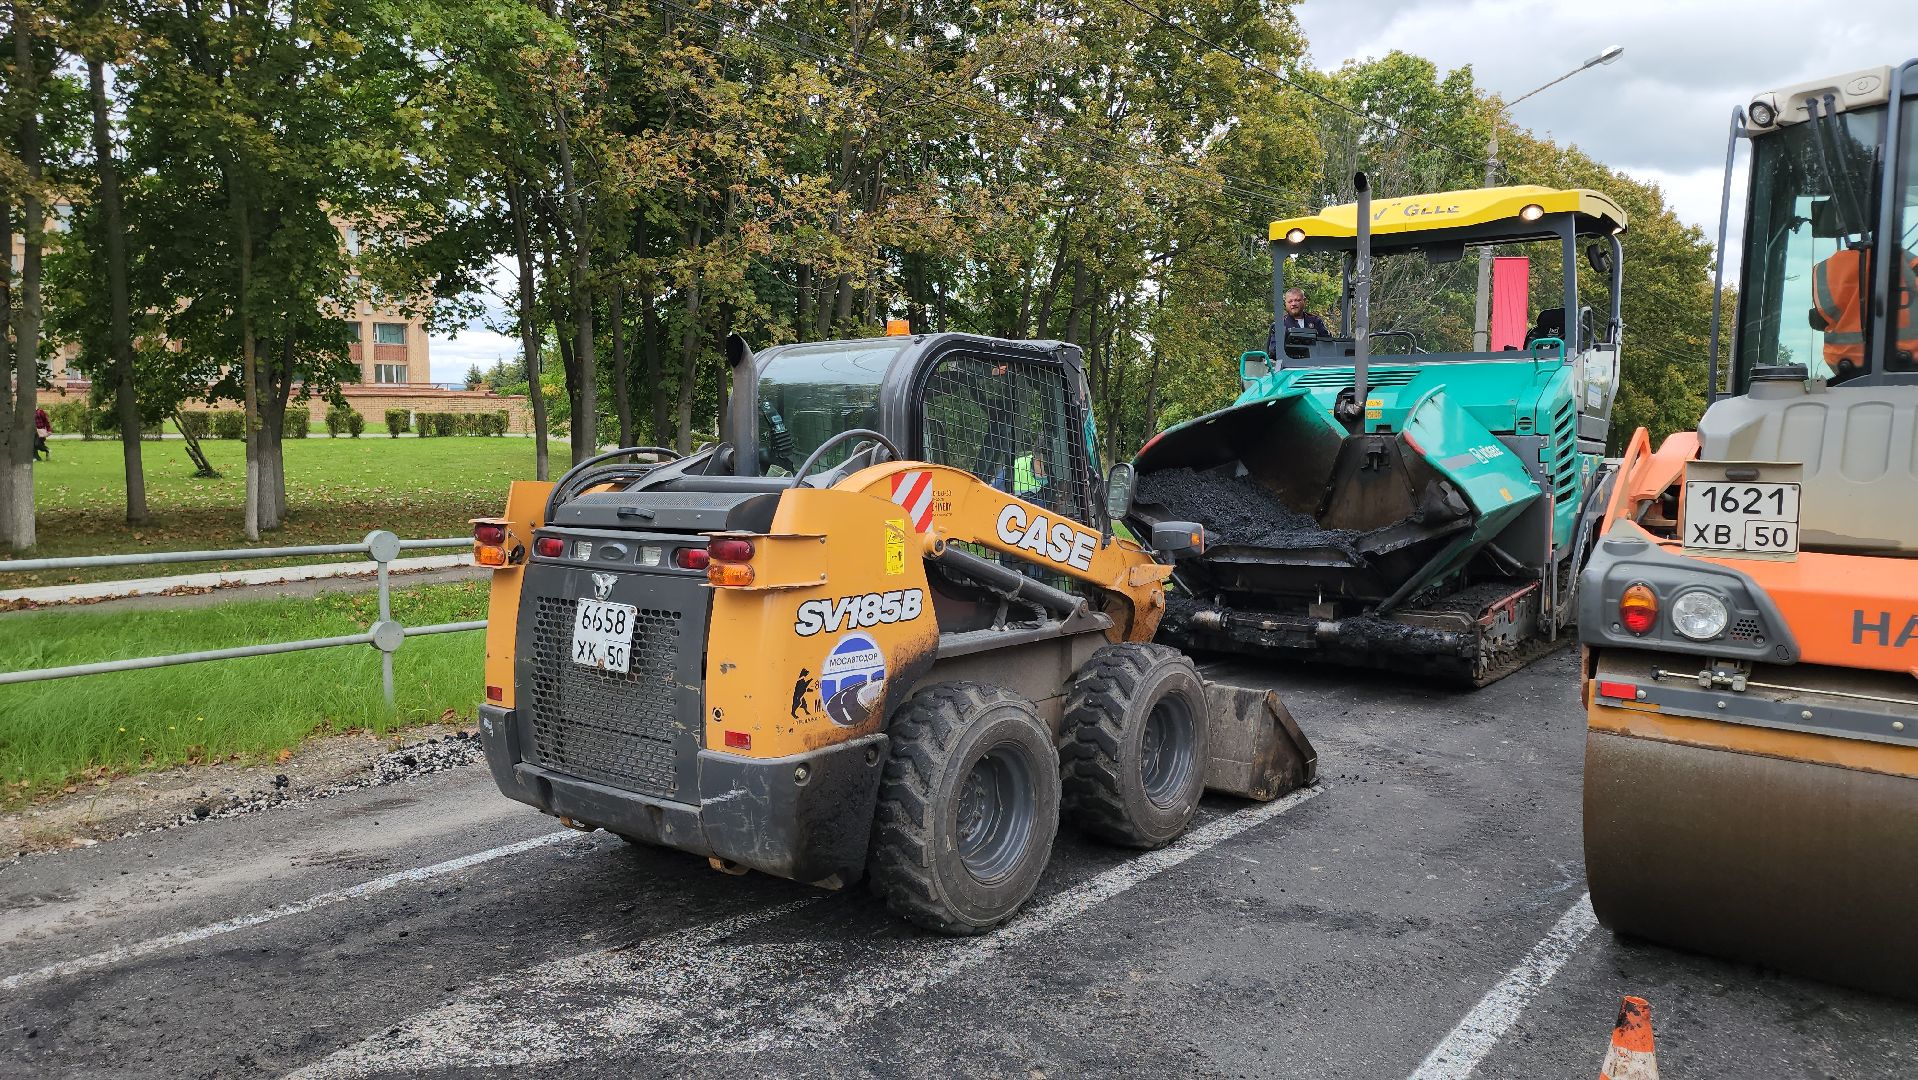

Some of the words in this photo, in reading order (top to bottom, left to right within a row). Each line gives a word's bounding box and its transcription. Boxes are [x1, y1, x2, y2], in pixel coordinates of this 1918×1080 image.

[1702, 486, 1783, 515] 1621
[996, 504, 1098, 572] CASE
[1754, 526, 1788, 547] 50
[582, 605, 626, 635] 6658
[794, 588, 923, 637] SV185B
[1852, 610, 1918, 647] HA
[608, 646, 623, 667] 50
[829, 652, 878, 668] МОСАВТОДОР
